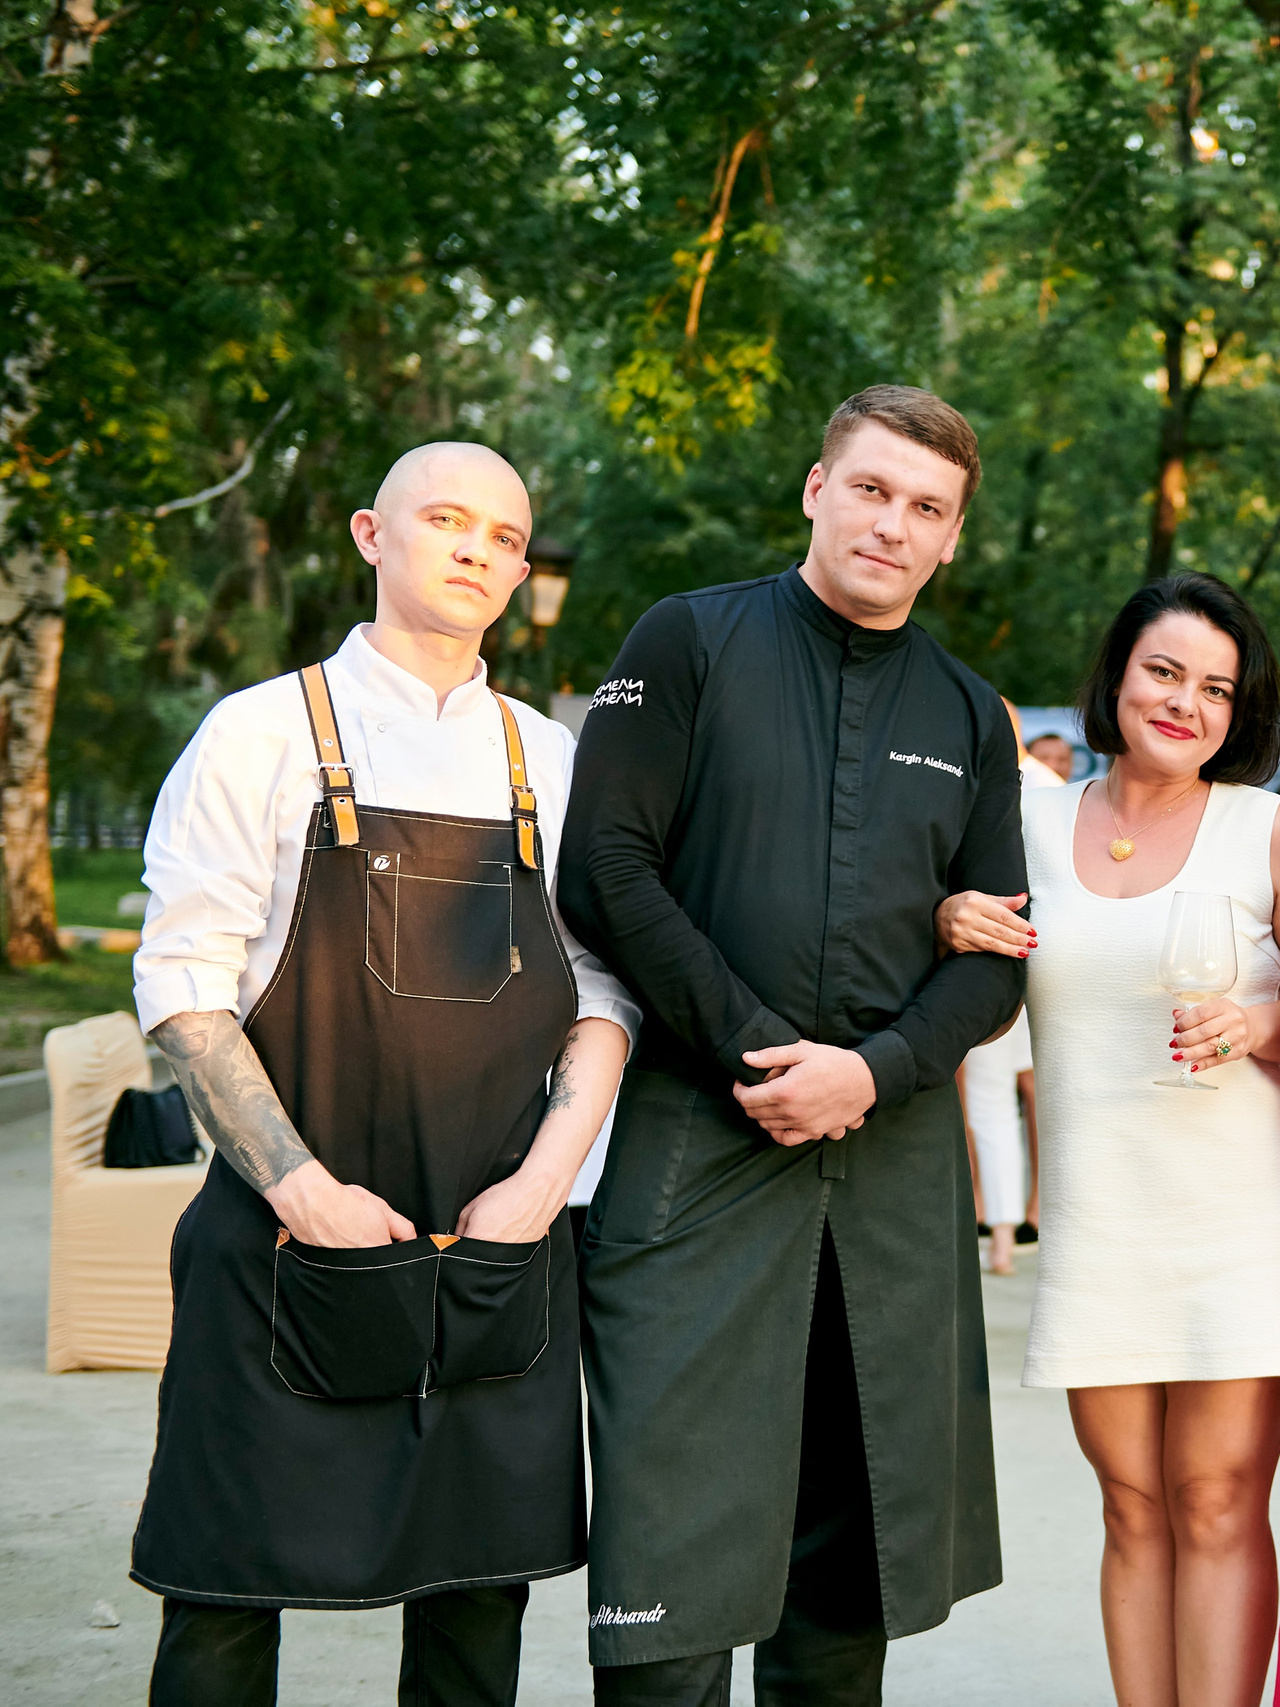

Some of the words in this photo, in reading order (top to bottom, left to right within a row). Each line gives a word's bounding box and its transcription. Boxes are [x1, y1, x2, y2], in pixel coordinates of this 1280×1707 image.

[889, 751, 922, 765] Kargin
[923, 756, 964, 777] Aleksandr
[590, 1602, 667, 1629] Aleksandr
